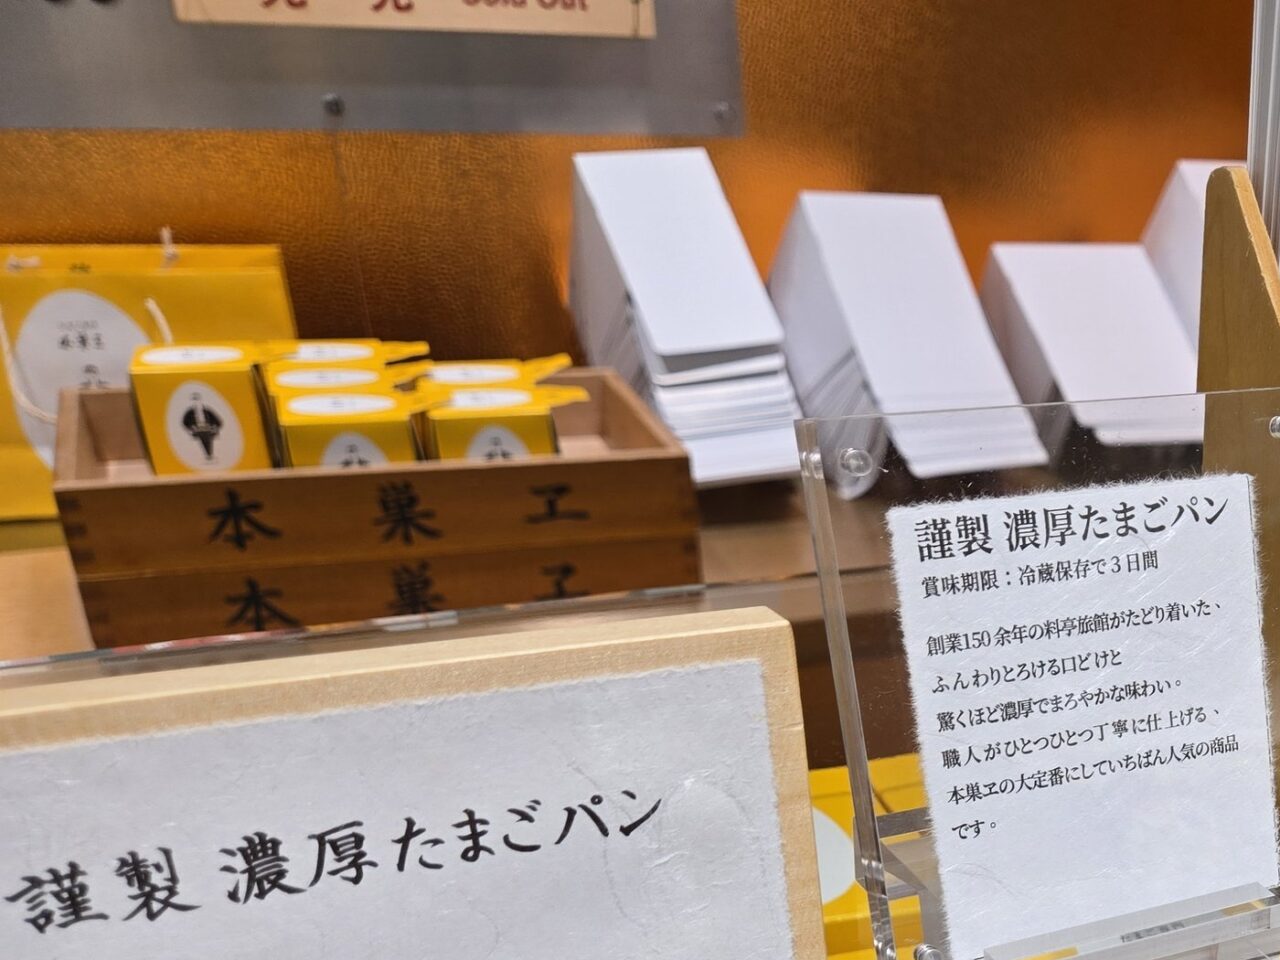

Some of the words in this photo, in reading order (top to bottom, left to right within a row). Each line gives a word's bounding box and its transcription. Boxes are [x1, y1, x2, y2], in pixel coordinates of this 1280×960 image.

[914, 513, 994, 562] 謹製
[1003, 496, 1229, 552] 濃厚たまごパン
[931, 650, 1123, 694] ふんわりとろける口どけと
[936, 679, 1182, 733] 驚くほど濃厚でまろやかな味わい。
[942, 706, 1220, 770] 職人がひとつひとつ丁寧に仕上げる、
[952, 820, 997, 841] です。
[3, 847, 201, 935] 謹製
[219, 789, 663, 905] 濃厚たまごパン
